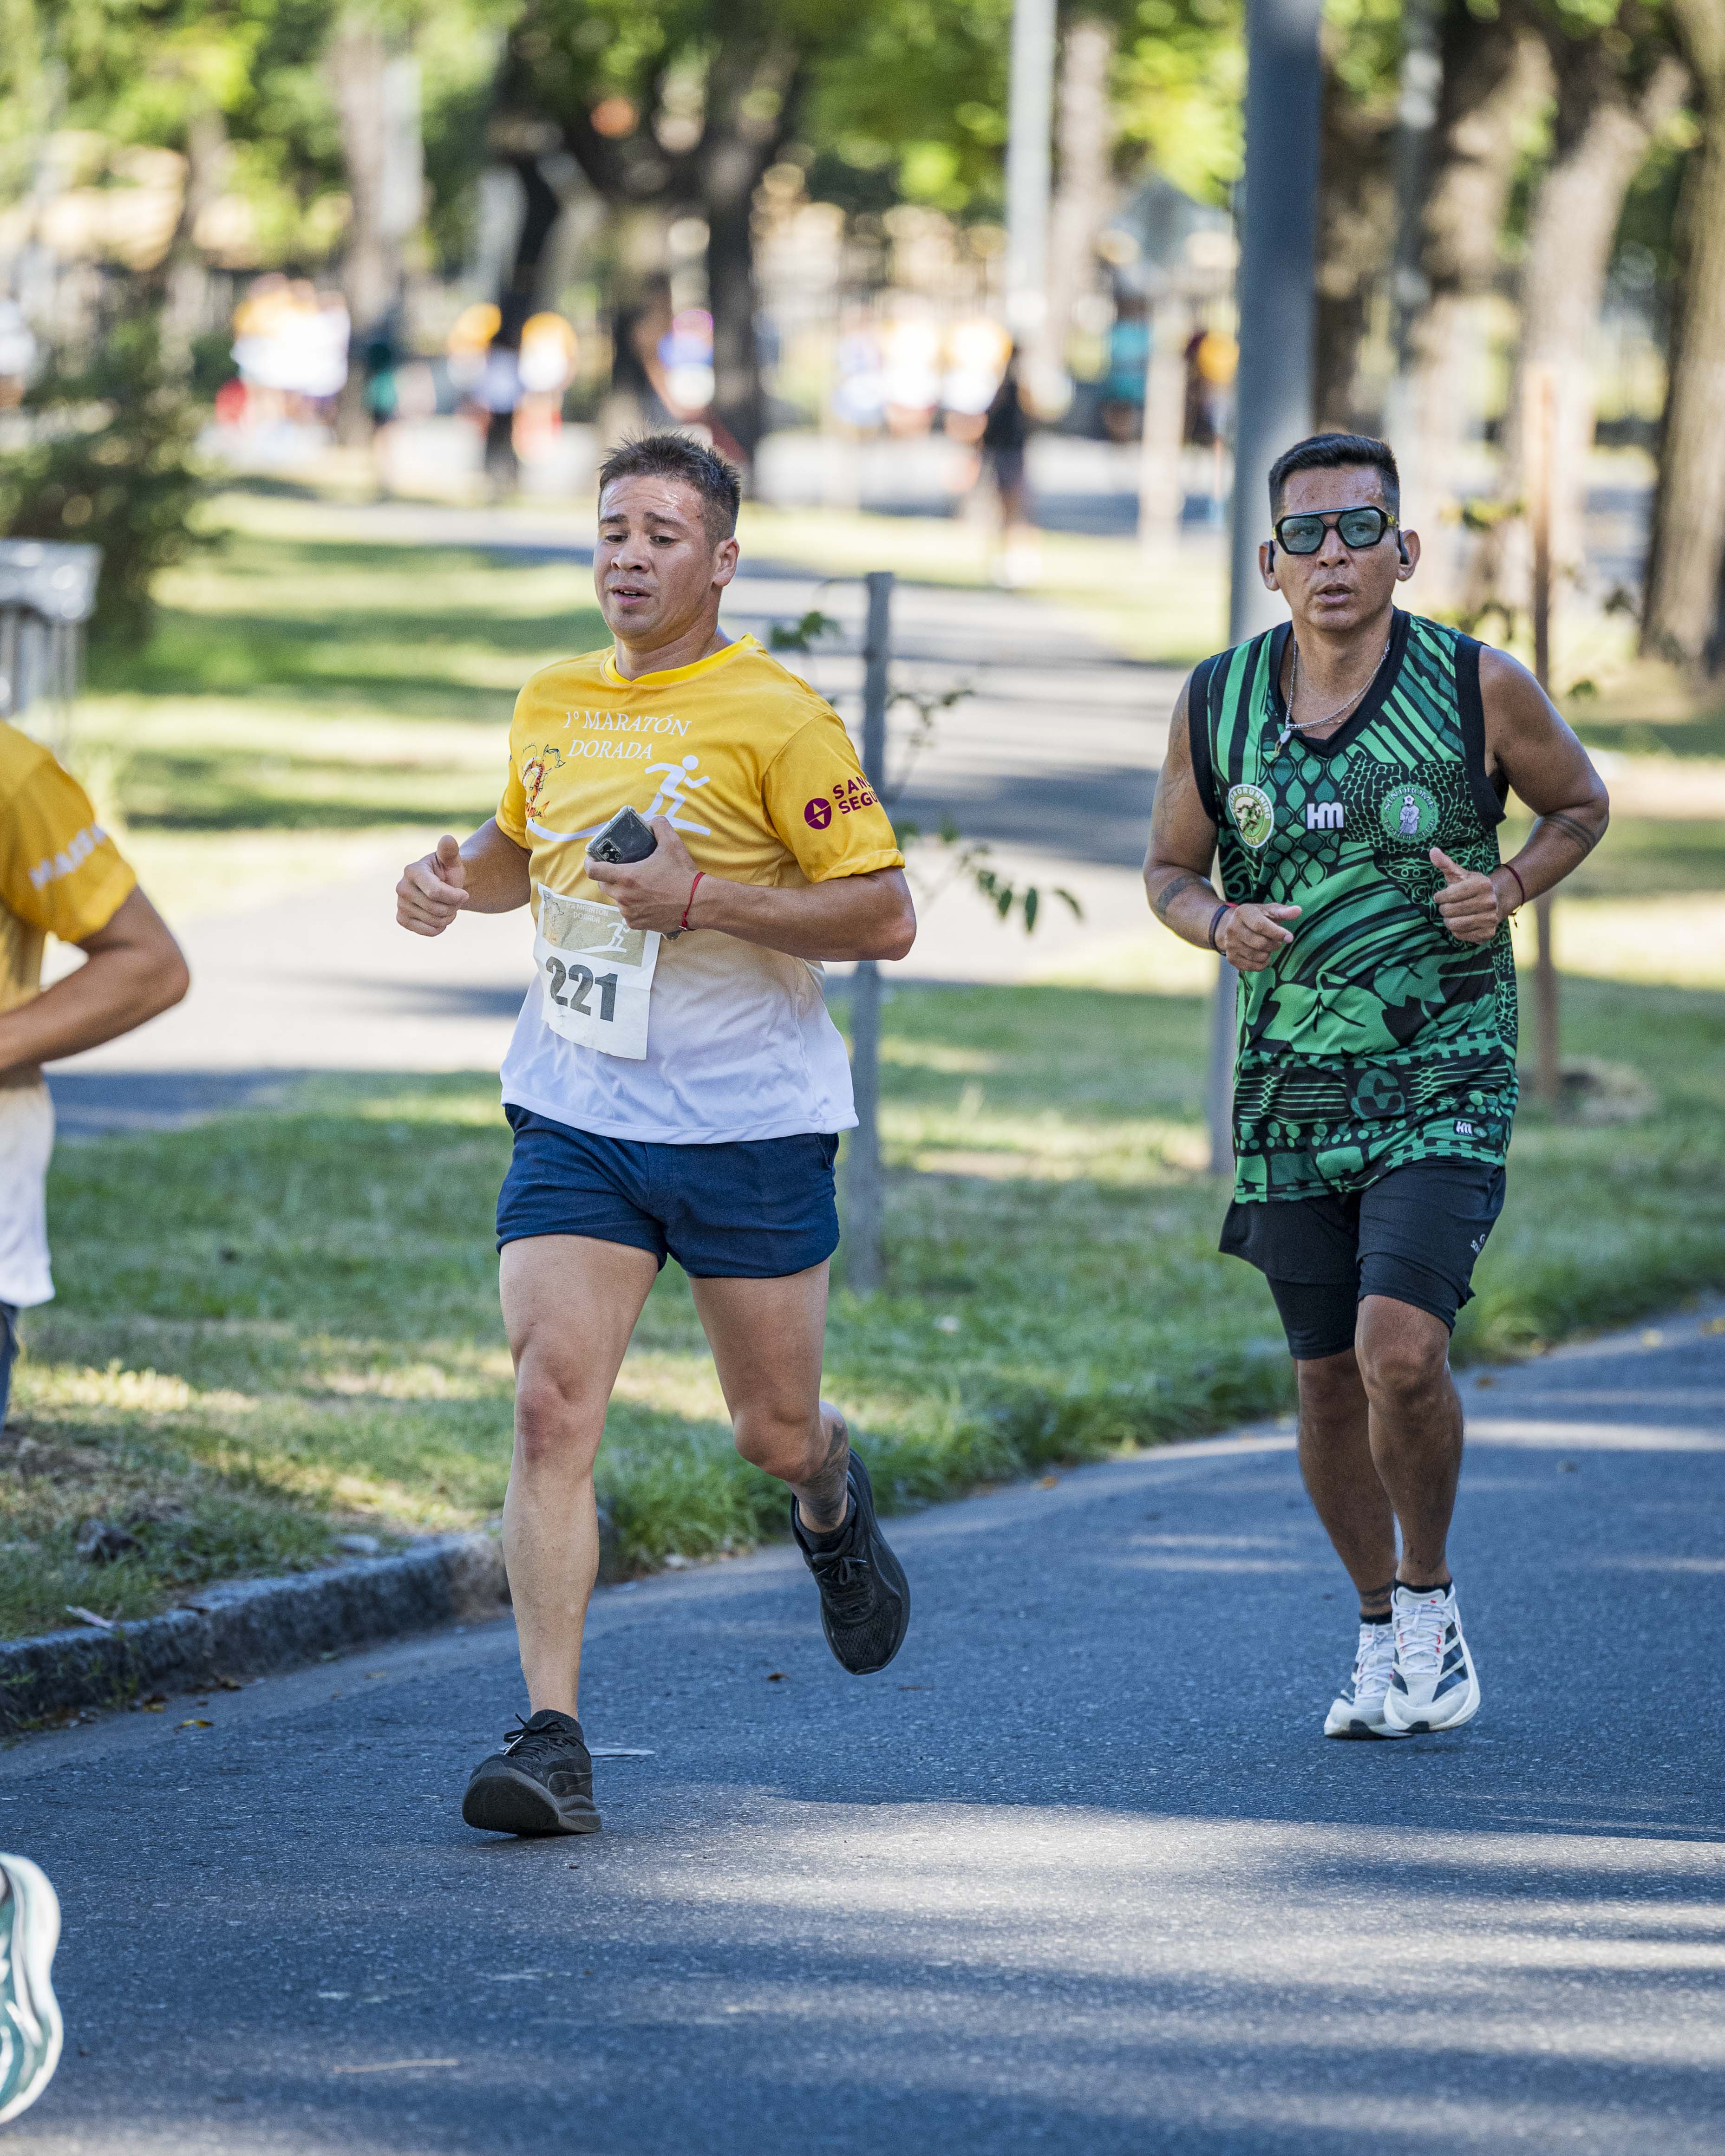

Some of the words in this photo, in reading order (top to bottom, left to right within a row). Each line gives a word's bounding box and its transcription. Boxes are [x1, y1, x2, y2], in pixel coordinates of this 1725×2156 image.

[581, 710, 692, 736] MARATÓN
[567, 739, 653, 760] DORADA
[838, 791, 879, 814] SEGU
[573, 912, 600, 924] DORADA
[545, 956, 618, 1022] 221
